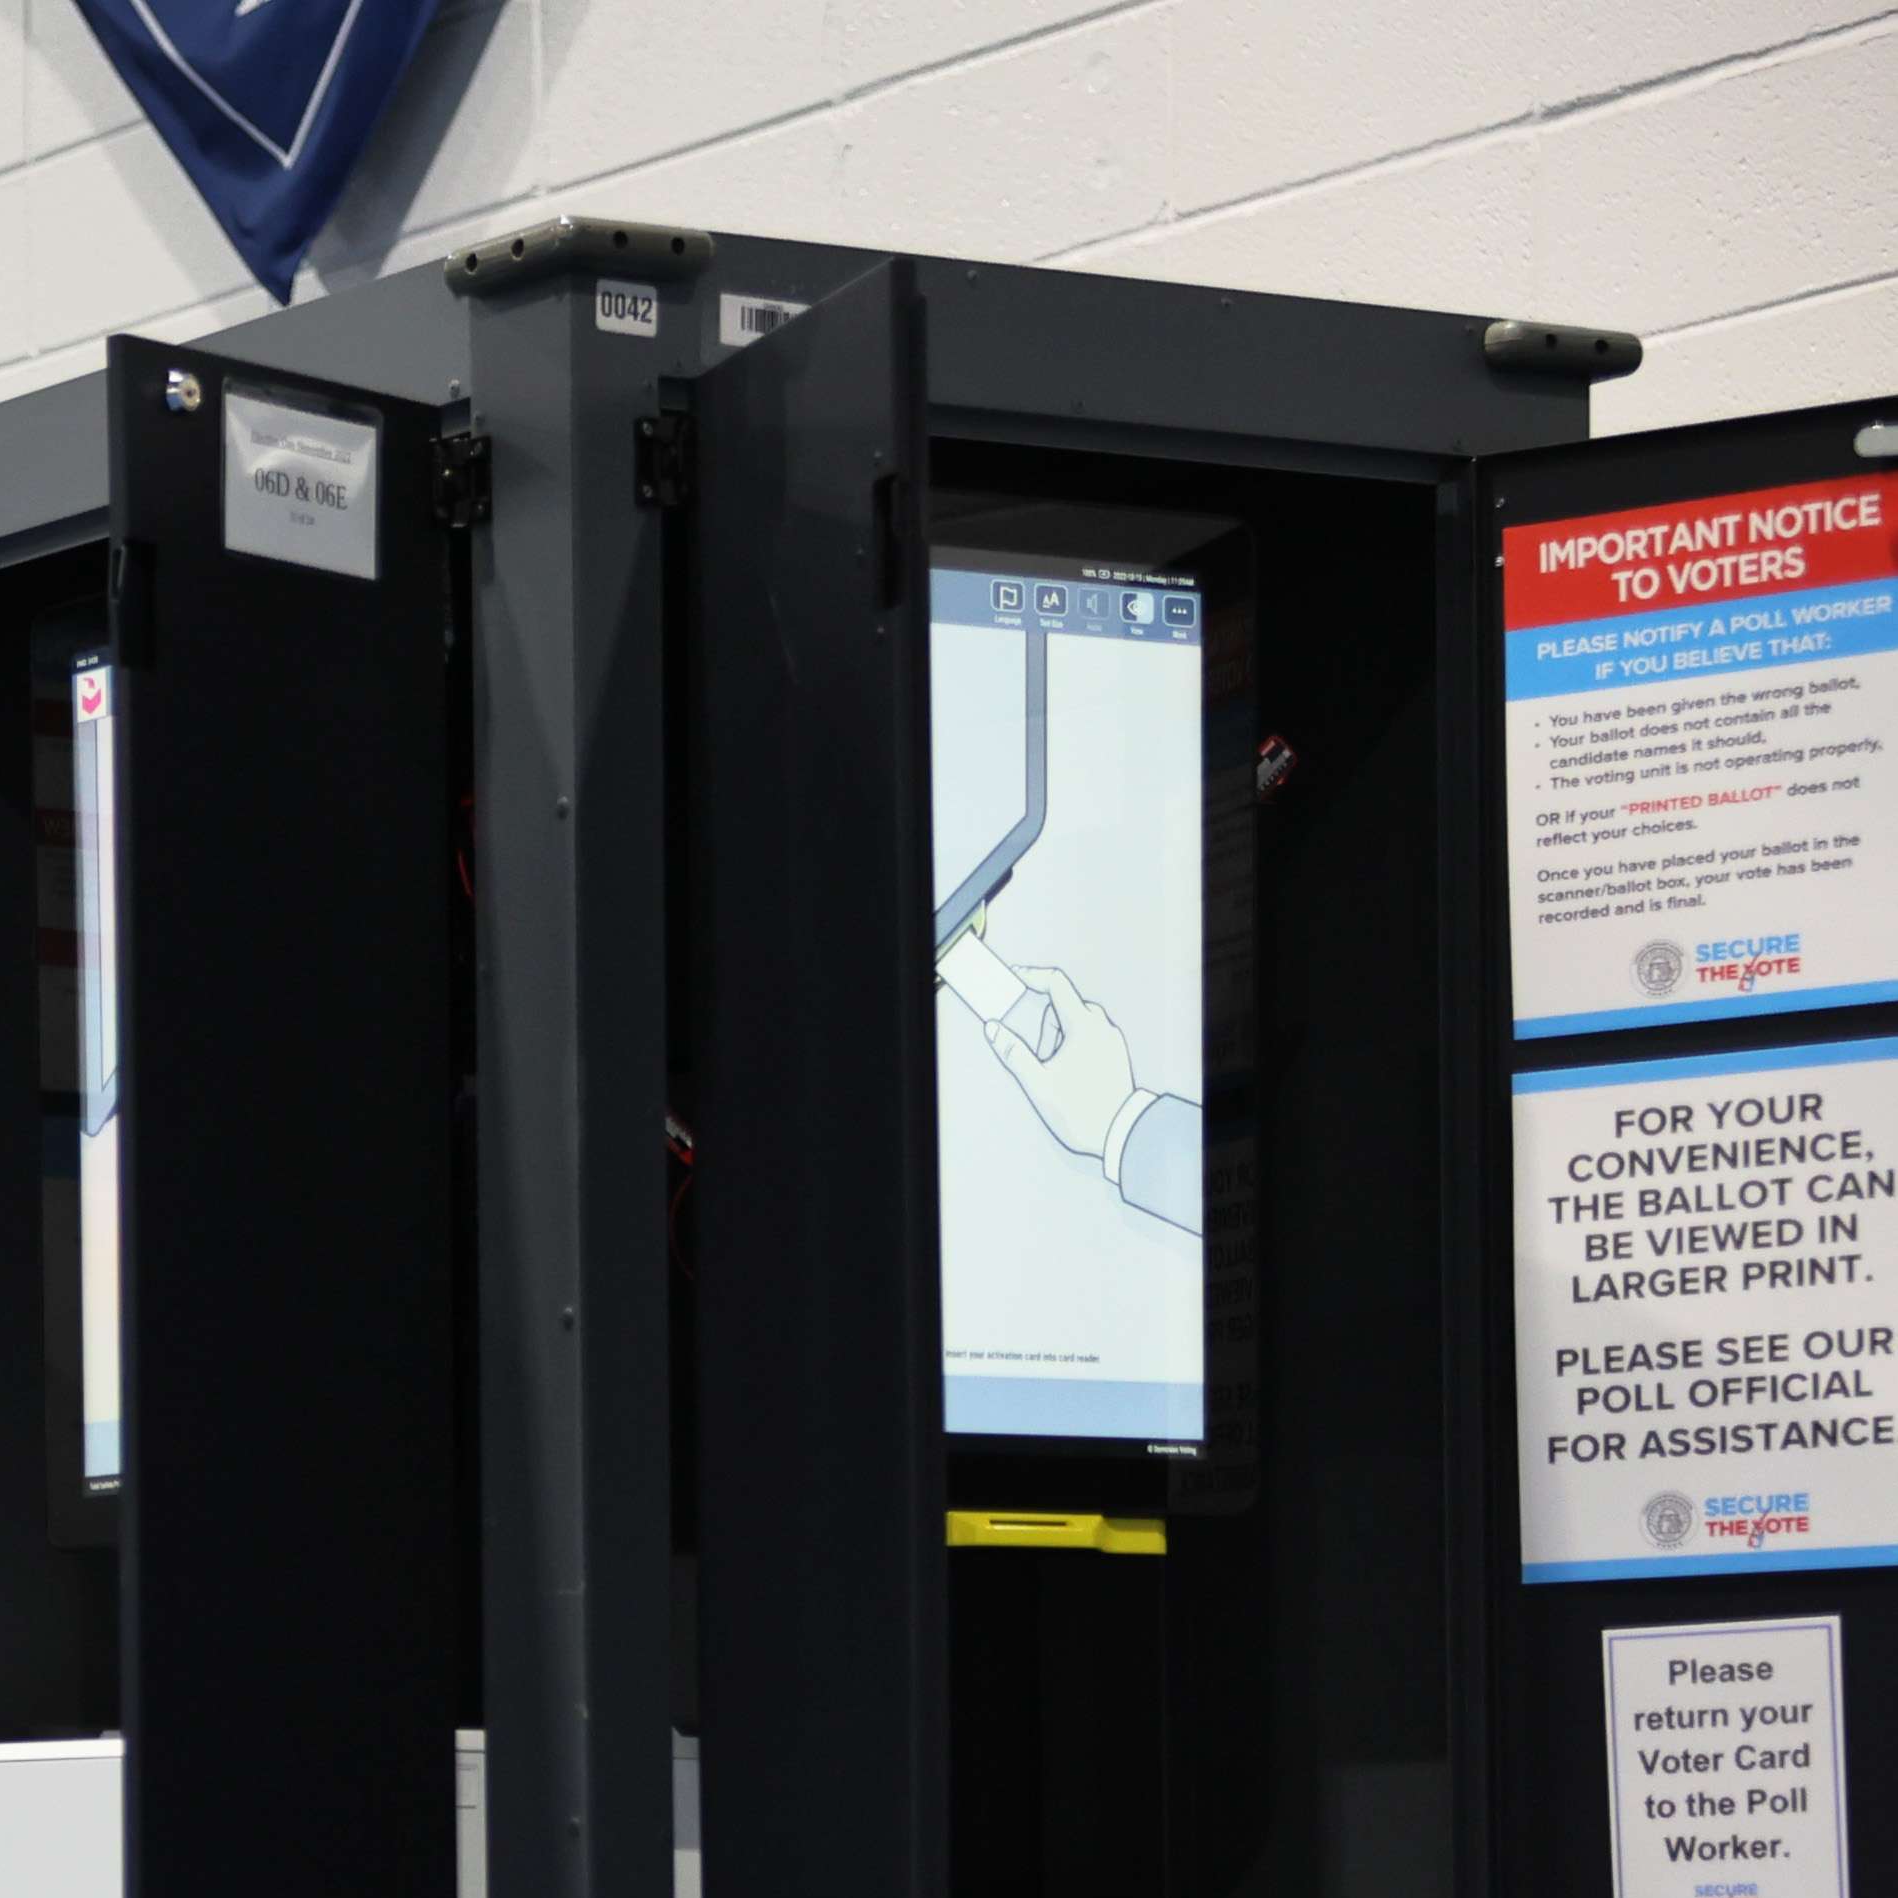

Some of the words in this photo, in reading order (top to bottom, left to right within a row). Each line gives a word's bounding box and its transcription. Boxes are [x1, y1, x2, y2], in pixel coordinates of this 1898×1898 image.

[601, 291, 654, 322] 0042
[255, 468, 290, 496] 06D
[295, 477, 309, 501] &
[315, 482, 348, 510] 06E
[1539, 514, 1741, 573] IMPORTANT
[1749, 494, 1882, 539] NOTICE
[1612, 570, 1660, 602] TO
[1669, 548, 1806, 594] VOTERS
[1537, 636, 1617, 660] PLEASE
[1623, 622, 1705, 654] NOTIFY
[1708, 618, 1725, 636] A
[1730, 609, 1787, 634] POLL
[1791, 594, 1892, 625] WORKER
[1596, 661, 1614, 680] IF
[1620, 655, 1667, 676] YOU
[1673, 642, 1763, 673] BELIEVE
[1767, 632, 1831, 656] THAT:
[1549, 715, 1578, 727] You
[1583, 710, 1622, 723] have
[1627, 704, 1666, 718] been
[1671, 698, 1715, 715] given
[1720, 692, 1747, 705] the
[1751, 686, 1804, 701] wrong
[1696, 934, 1801, 964] SECURE
[1615, 1105, 1693, 1138] FOR
[1707, 1093, 1823, 1129] YOUR
[1567, 1130, 1874, 1183] CONVENIENCE,
[1548, 1192, 1623, 1224] THE
[1639, 1177, 1792, 1217] BALLOT
[1807, 1169, 1895, 1203] CAN
[1586, 1232, 1632, 1262] BE
[1646, 1219, 1804, 1256] VIEWED
[1819, 1214, 1857, 1243] IN
[1573, 1265, 1727, 1303] LARGER
[1743, 1254, 1872, 1290] PRINT.
[1025, 1352, 1041, 1361] card
[1059, 1353, 1075, 1362] card
[1556, 1340, 1702, 1377] PLEASE
[1717, 1334, 1788, 1366] SEE
[1804, 1327, 1893, 1359] OUR
[1577, 1383, 1675, 1415] POLL
[1689, 1370, 1872, 1408] OFFICIAL
[1548, 1433, 1626, 1464] FOR
[1639, 1416, 1893, 1458] ASSISTANCE
[1669, 1659, 1773, 1685] Please
[1634, 1707, 1728, 1731] return
[1740, 1704, 1813, 1732] your
[1638, 1750, 1723, 1775] Voter
[1735, 1743, 1810, 1770] Card
[1645, 1795, 1676, 1819] to
[1686, 1792, 1735, 1817] the
[1747, 1787, 1807, 1814] Poll
[1664, 1835, 1789, 1862] Worker.
